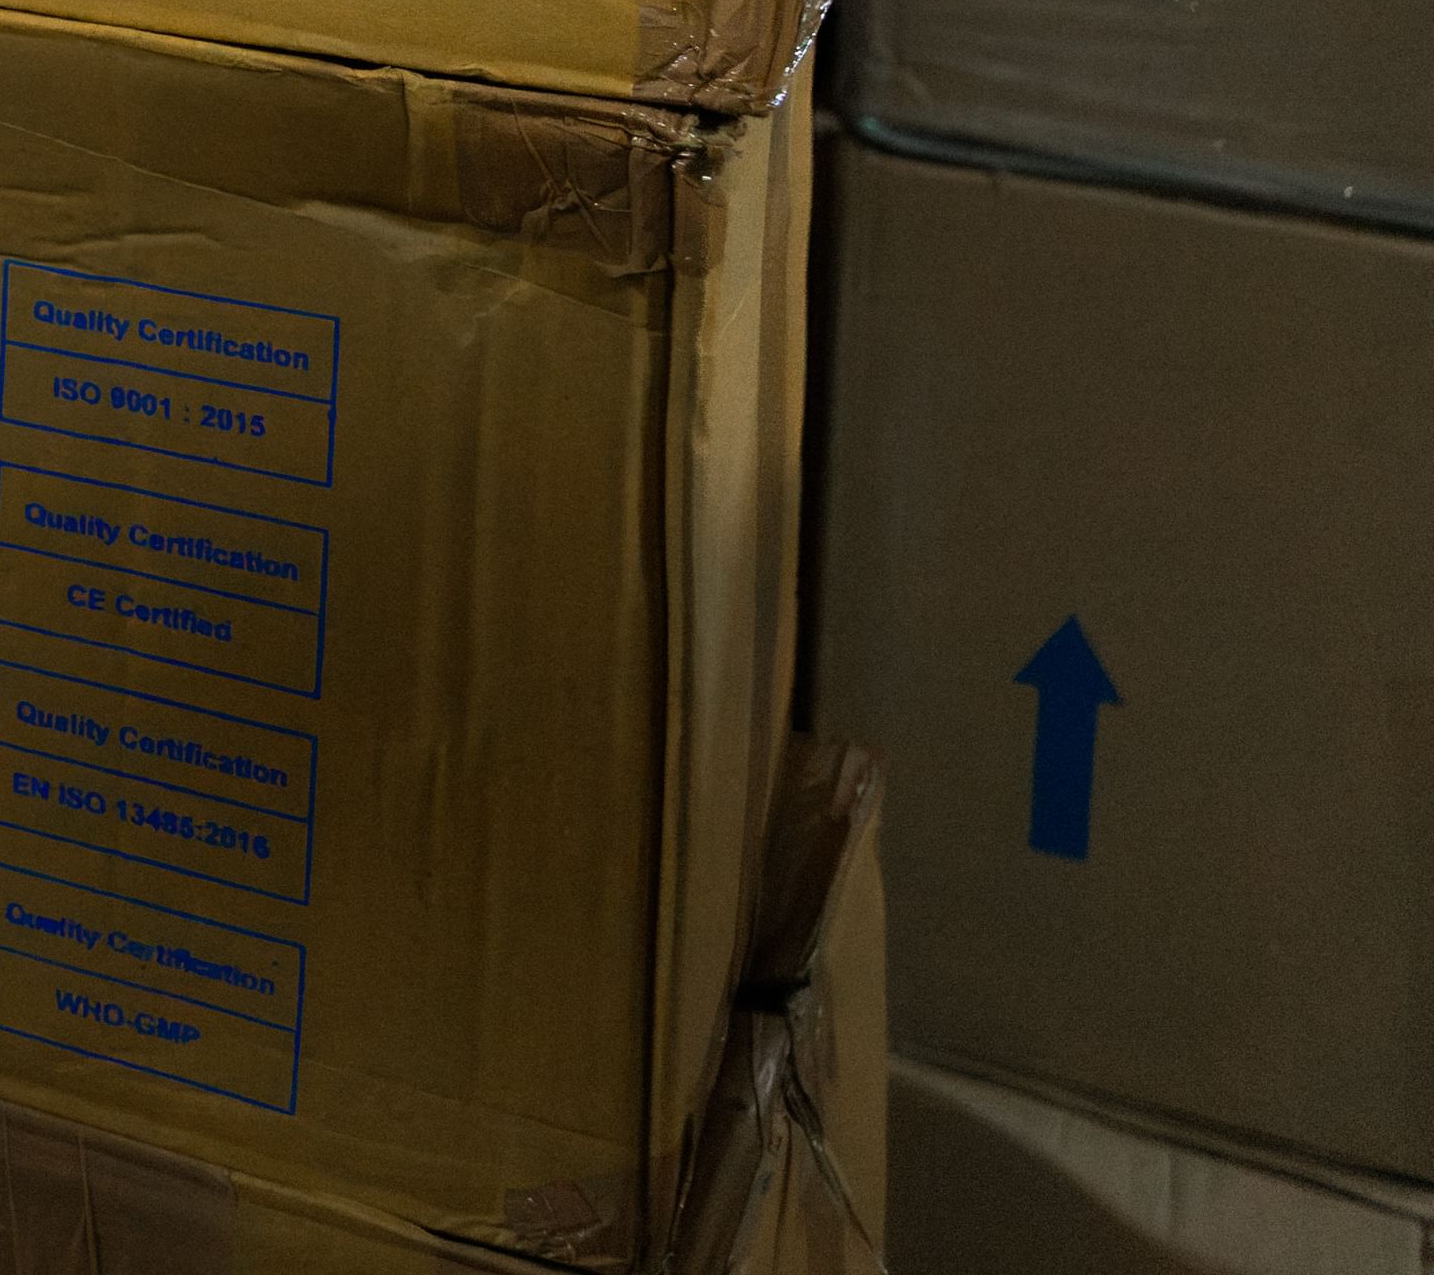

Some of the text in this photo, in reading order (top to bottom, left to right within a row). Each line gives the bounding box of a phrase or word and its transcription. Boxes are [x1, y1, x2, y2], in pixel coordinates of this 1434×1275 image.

[33, 300, 309, 371] Quality Certification
[53, 376, 102, 405] ISO
[111, 389, 172, 421] 9001
[200, 404, 266, 437] 2015
[24, 502, 299, 582] Quality Certification
[67, 583, 233, 643] CE Certified
[16, 700, 289, 789] Quality Certification
[12, 771, 271, 860] EN ISO 13485:2016
[5, 901, 276, 996] Quality Certification
[55, 988, 200, 1045] WHO-GMP
